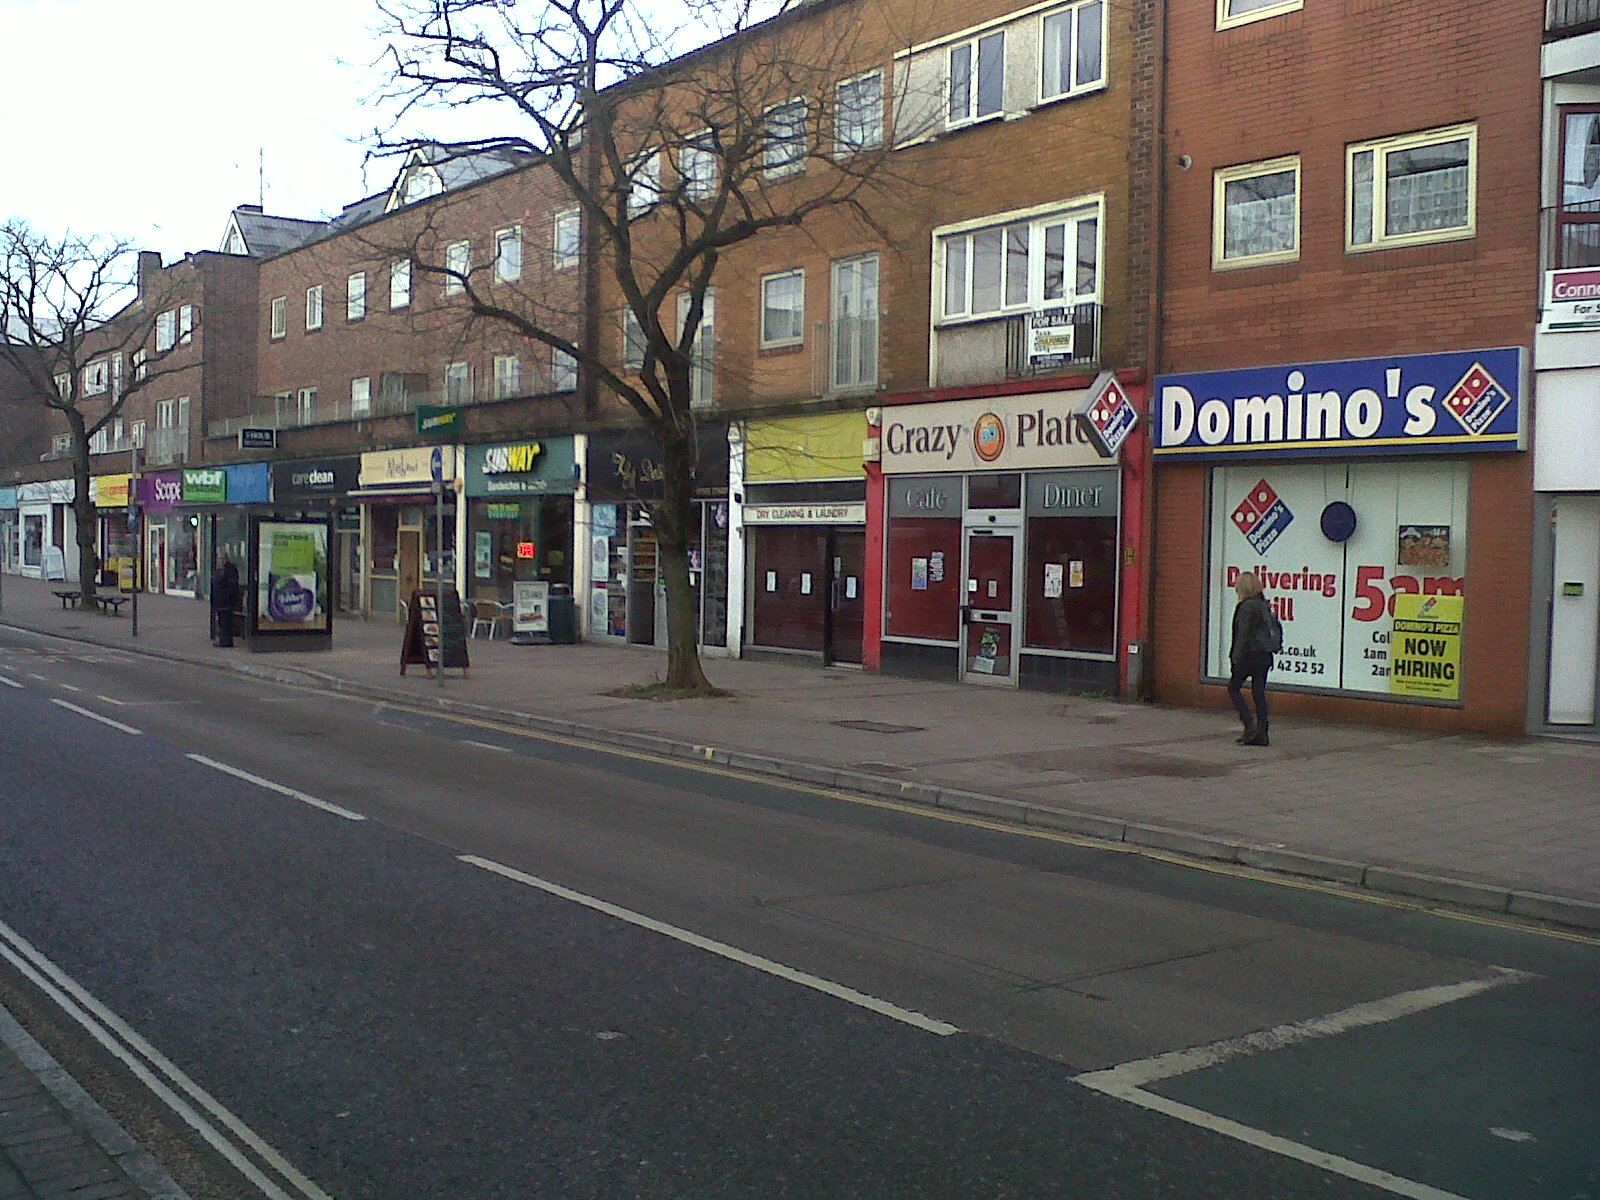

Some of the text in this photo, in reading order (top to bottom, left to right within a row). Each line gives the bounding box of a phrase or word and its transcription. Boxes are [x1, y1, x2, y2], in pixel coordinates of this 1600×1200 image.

[1573, 304, 1592, 314] For
[1161, 368, 1436, 446] Domino's
[1103, 404, 1129, 438] Domino's
[887, 423, 961, 460] Crazy
[481, 442, 541, 474] SUBWAY
[155, 478, 181, 504] Scope
[1043, 481, 1103, 509] Diner
[756, 510, 769, 519] DRY
[771, 508, 804, 519] CLEANING
[815, 507, 848, 518] LAUNDRY
[1248, 505, 1284, 544] Domino's
[1256, 528, 1278, 553] Pizza
[1227, 565, 1336, 598] Dlivering
[1364, 648, 1387, 660] 1am
[1404, 638, 1446, 657] NOW
[1277, 660, 1291, 672] 42
[1295, 661, 1308, 673] 52
[1311, 662, 1324, 675] 52
[1394, 659, 1455, 680] HIRING
